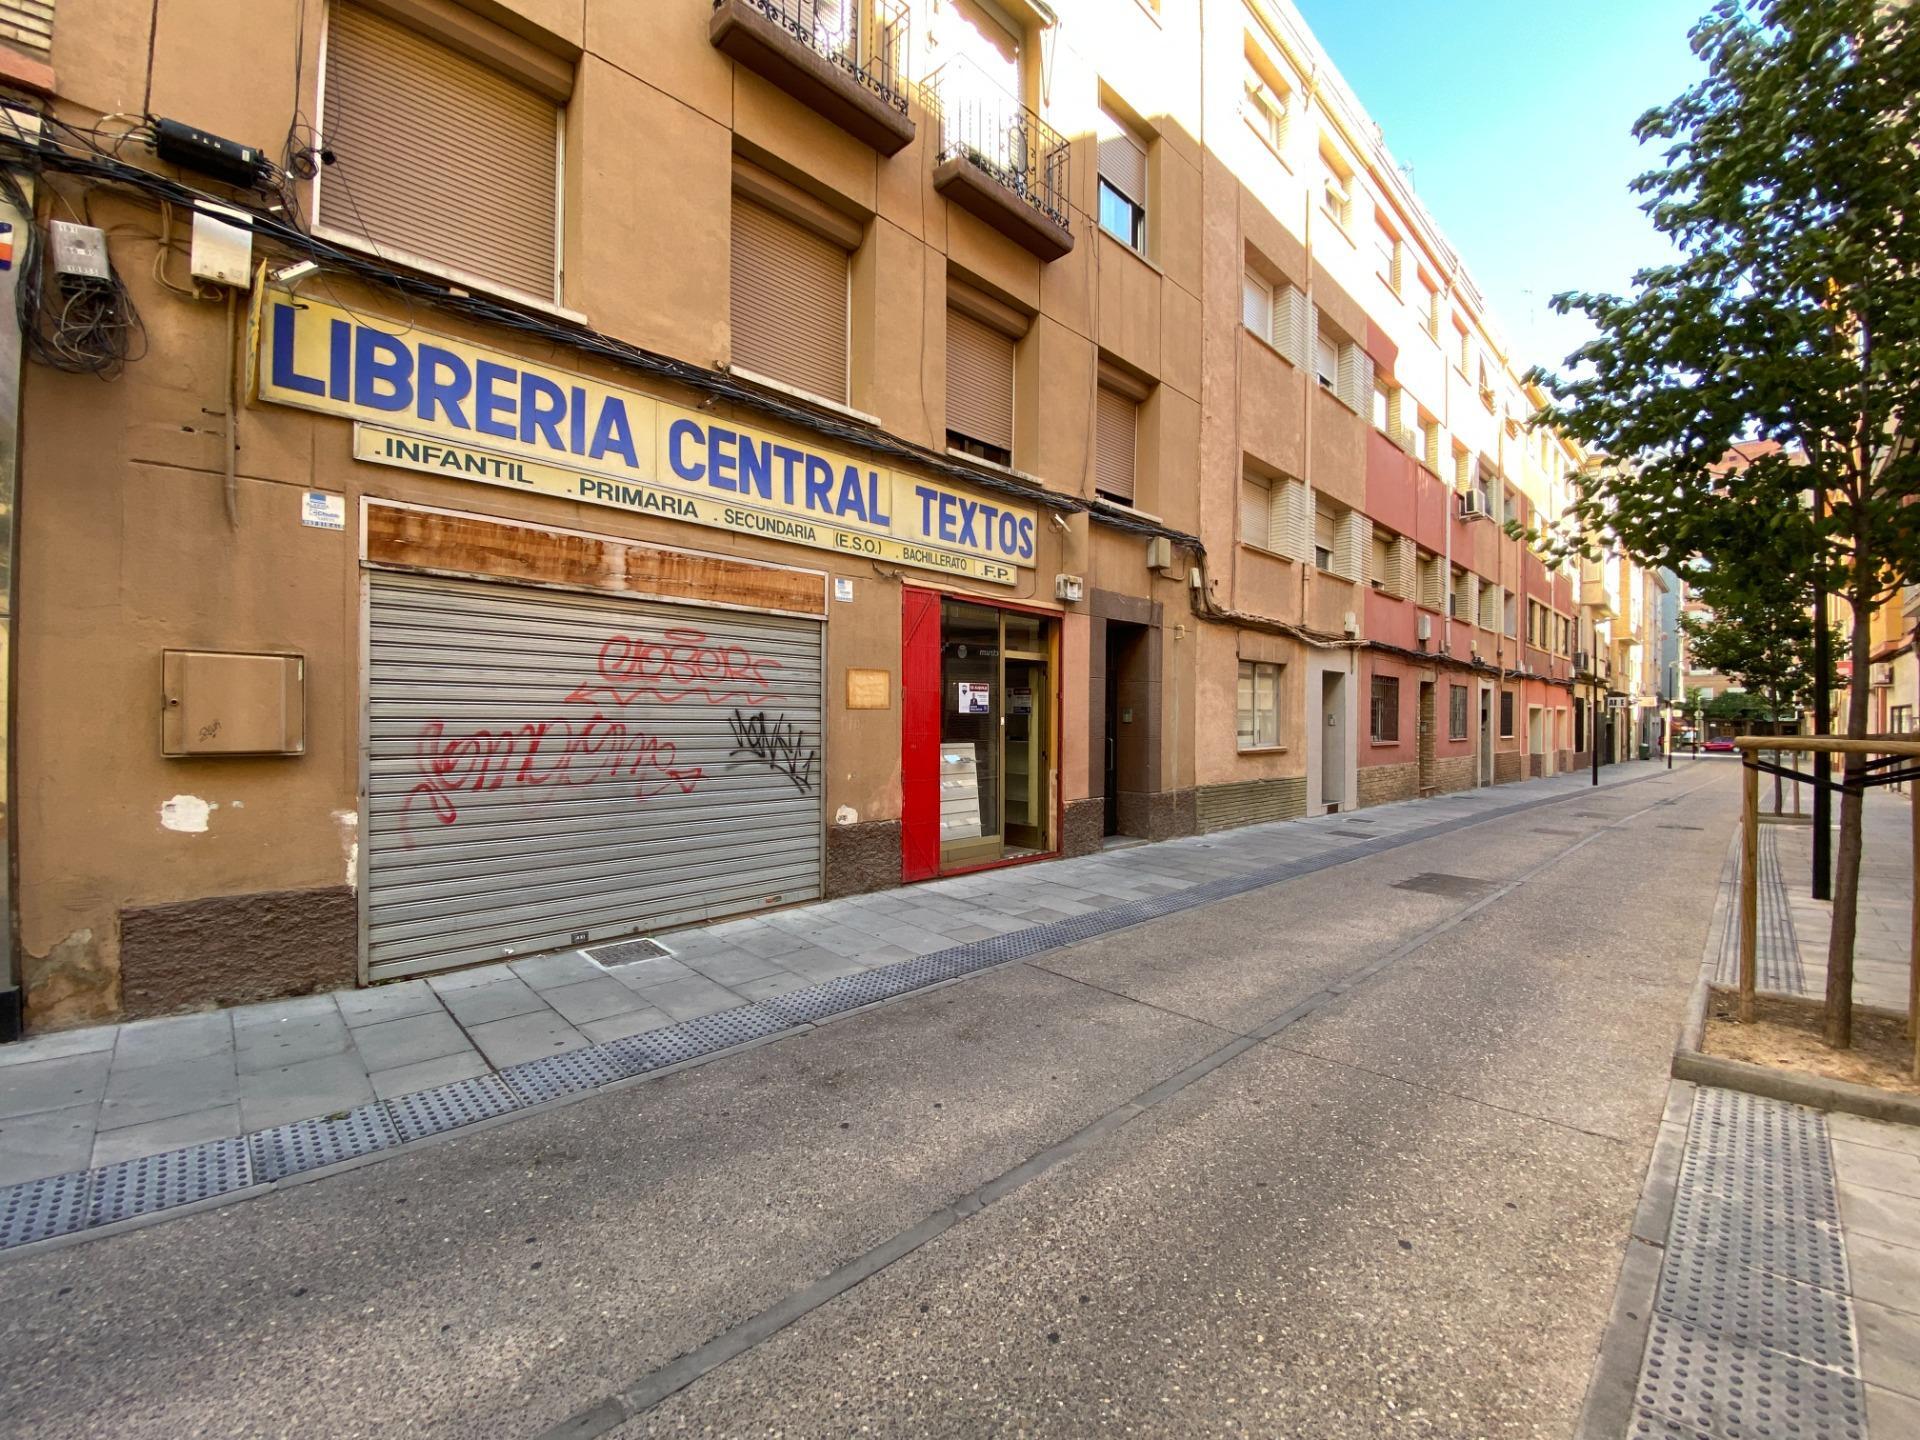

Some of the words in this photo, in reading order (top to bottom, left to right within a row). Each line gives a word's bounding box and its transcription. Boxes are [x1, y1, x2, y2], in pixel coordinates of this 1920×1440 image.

[271, 302, 640, 469] LIBRERIA
[668, 418, 891, 528] CENTRAL
[914, 484, 1034, 560] TEXTOS
